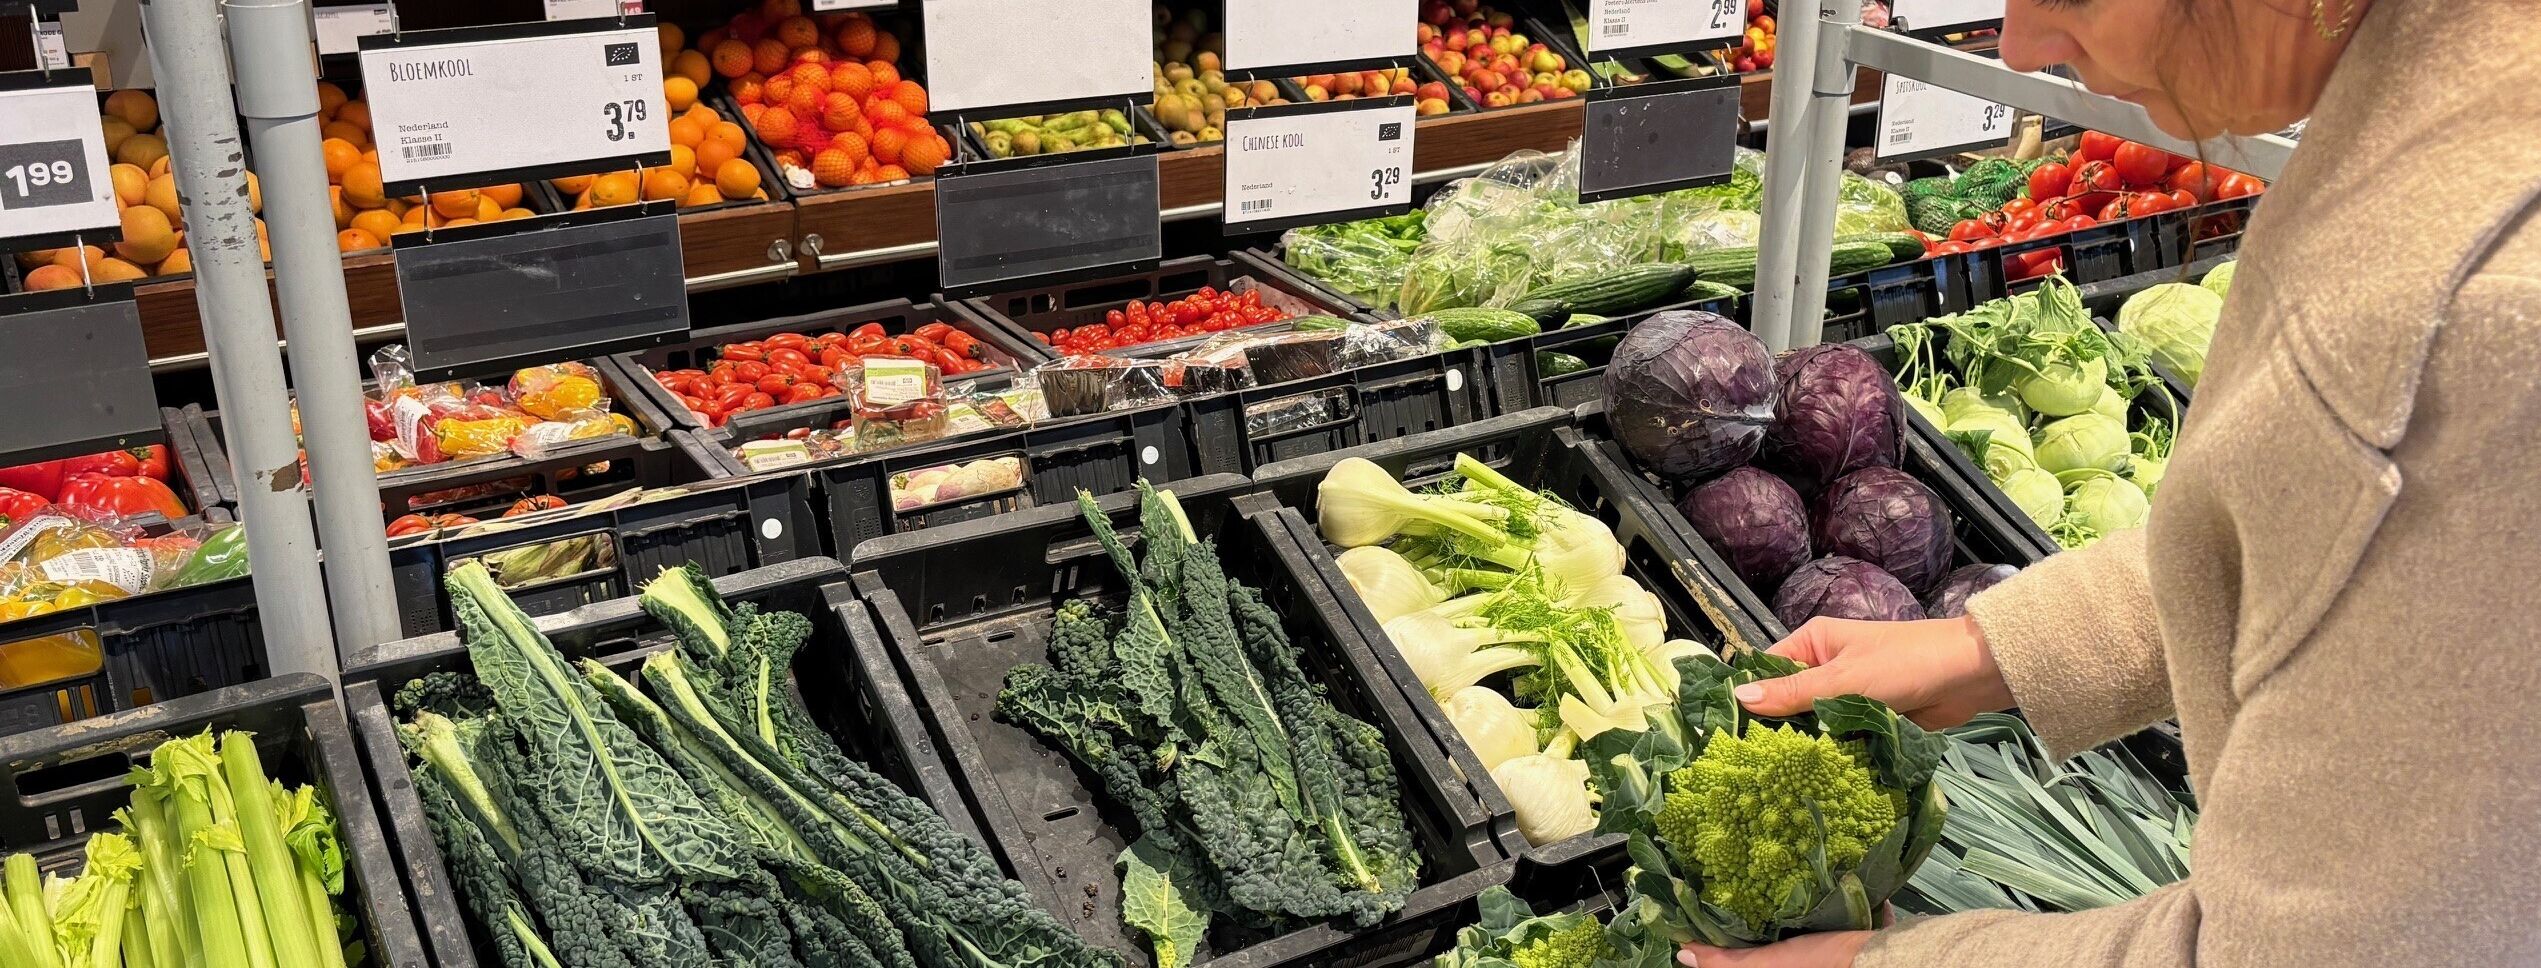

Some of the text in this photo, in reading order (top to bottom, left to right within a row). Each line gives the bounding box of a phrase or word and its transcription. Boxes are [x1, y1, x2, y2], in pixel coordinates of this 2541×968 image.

[389, 58, 474, 82] BLOEMKOOL
[624, 73, 643, 82] 1 ST
[398, 121, 449, 132] Nederland
[603, 98, 647, 141] 3.79
[400, 133, 442, 144] Klasse II
[1242, 133, 1304, 152] CHINESE KOOL
[5, 160, 74, 196] 199
[1241, 182, 1273, 190] Nederland
[1370, 166, 1400, 200] 3.29
